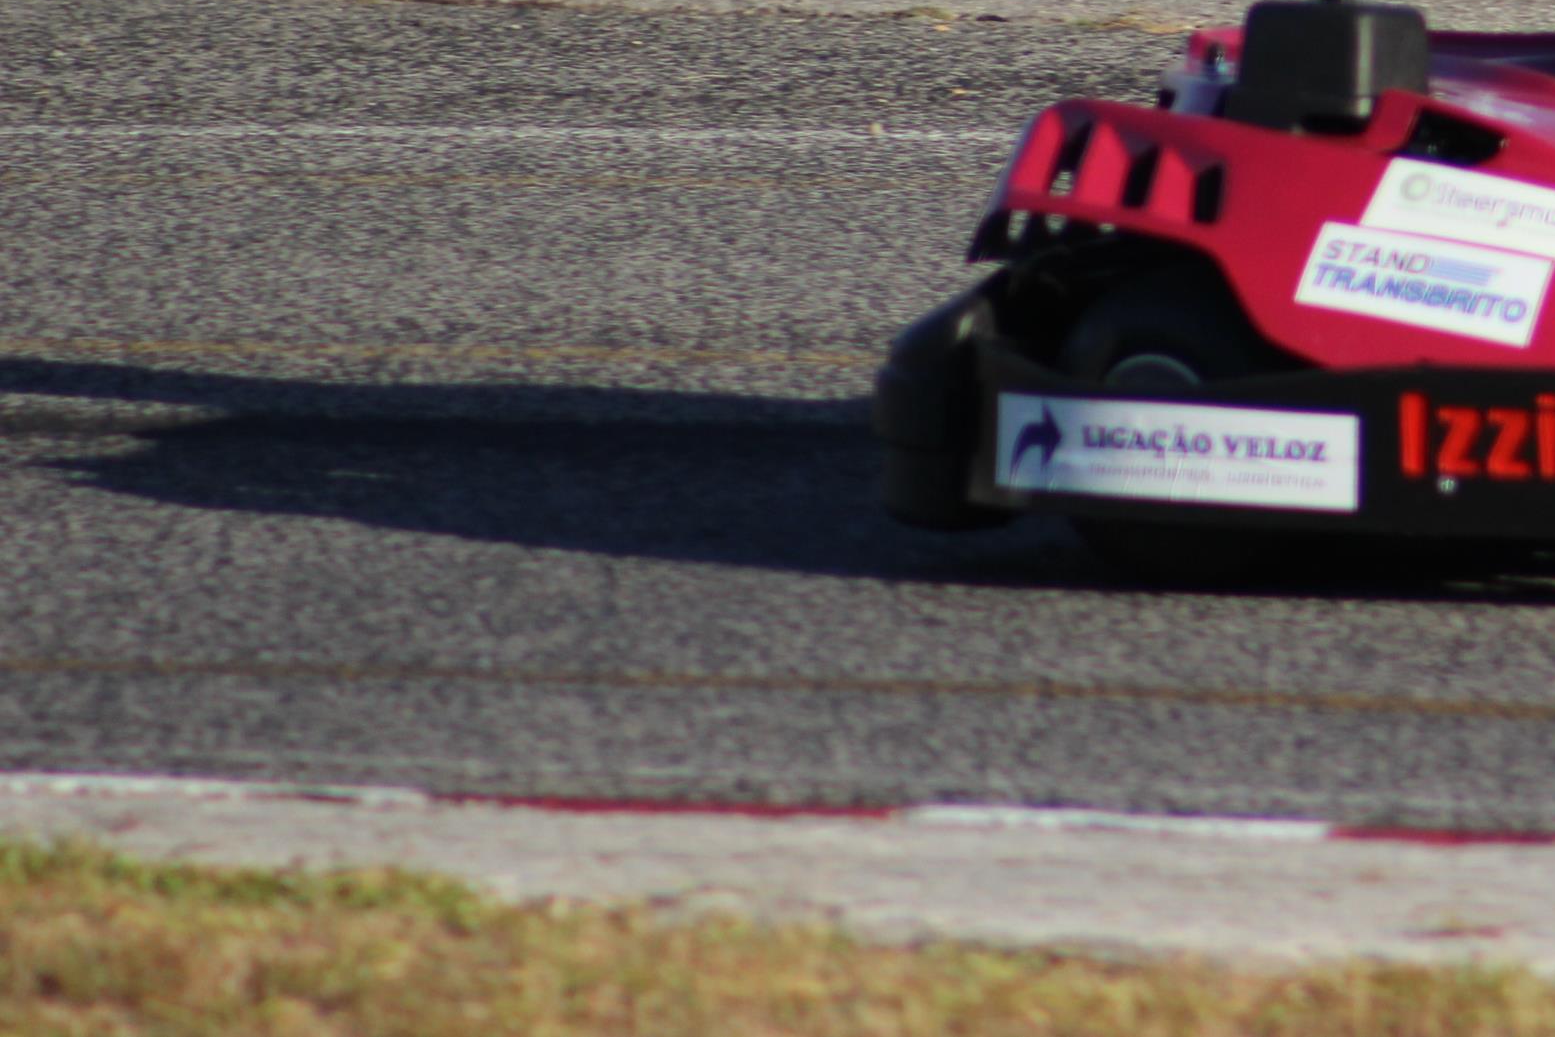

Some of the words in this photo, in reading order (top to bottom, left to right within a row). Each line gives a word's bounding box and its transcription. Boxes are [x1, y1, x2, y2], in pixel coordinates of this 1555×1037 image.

[1324, 239, 1429, 274] STAND
[1313, 262, 1527, 323] TRANSBRITO
[1082, 423, 1212, 459] LIGAÇÃO
[1223, 434, 1328, 462] VELOZ
